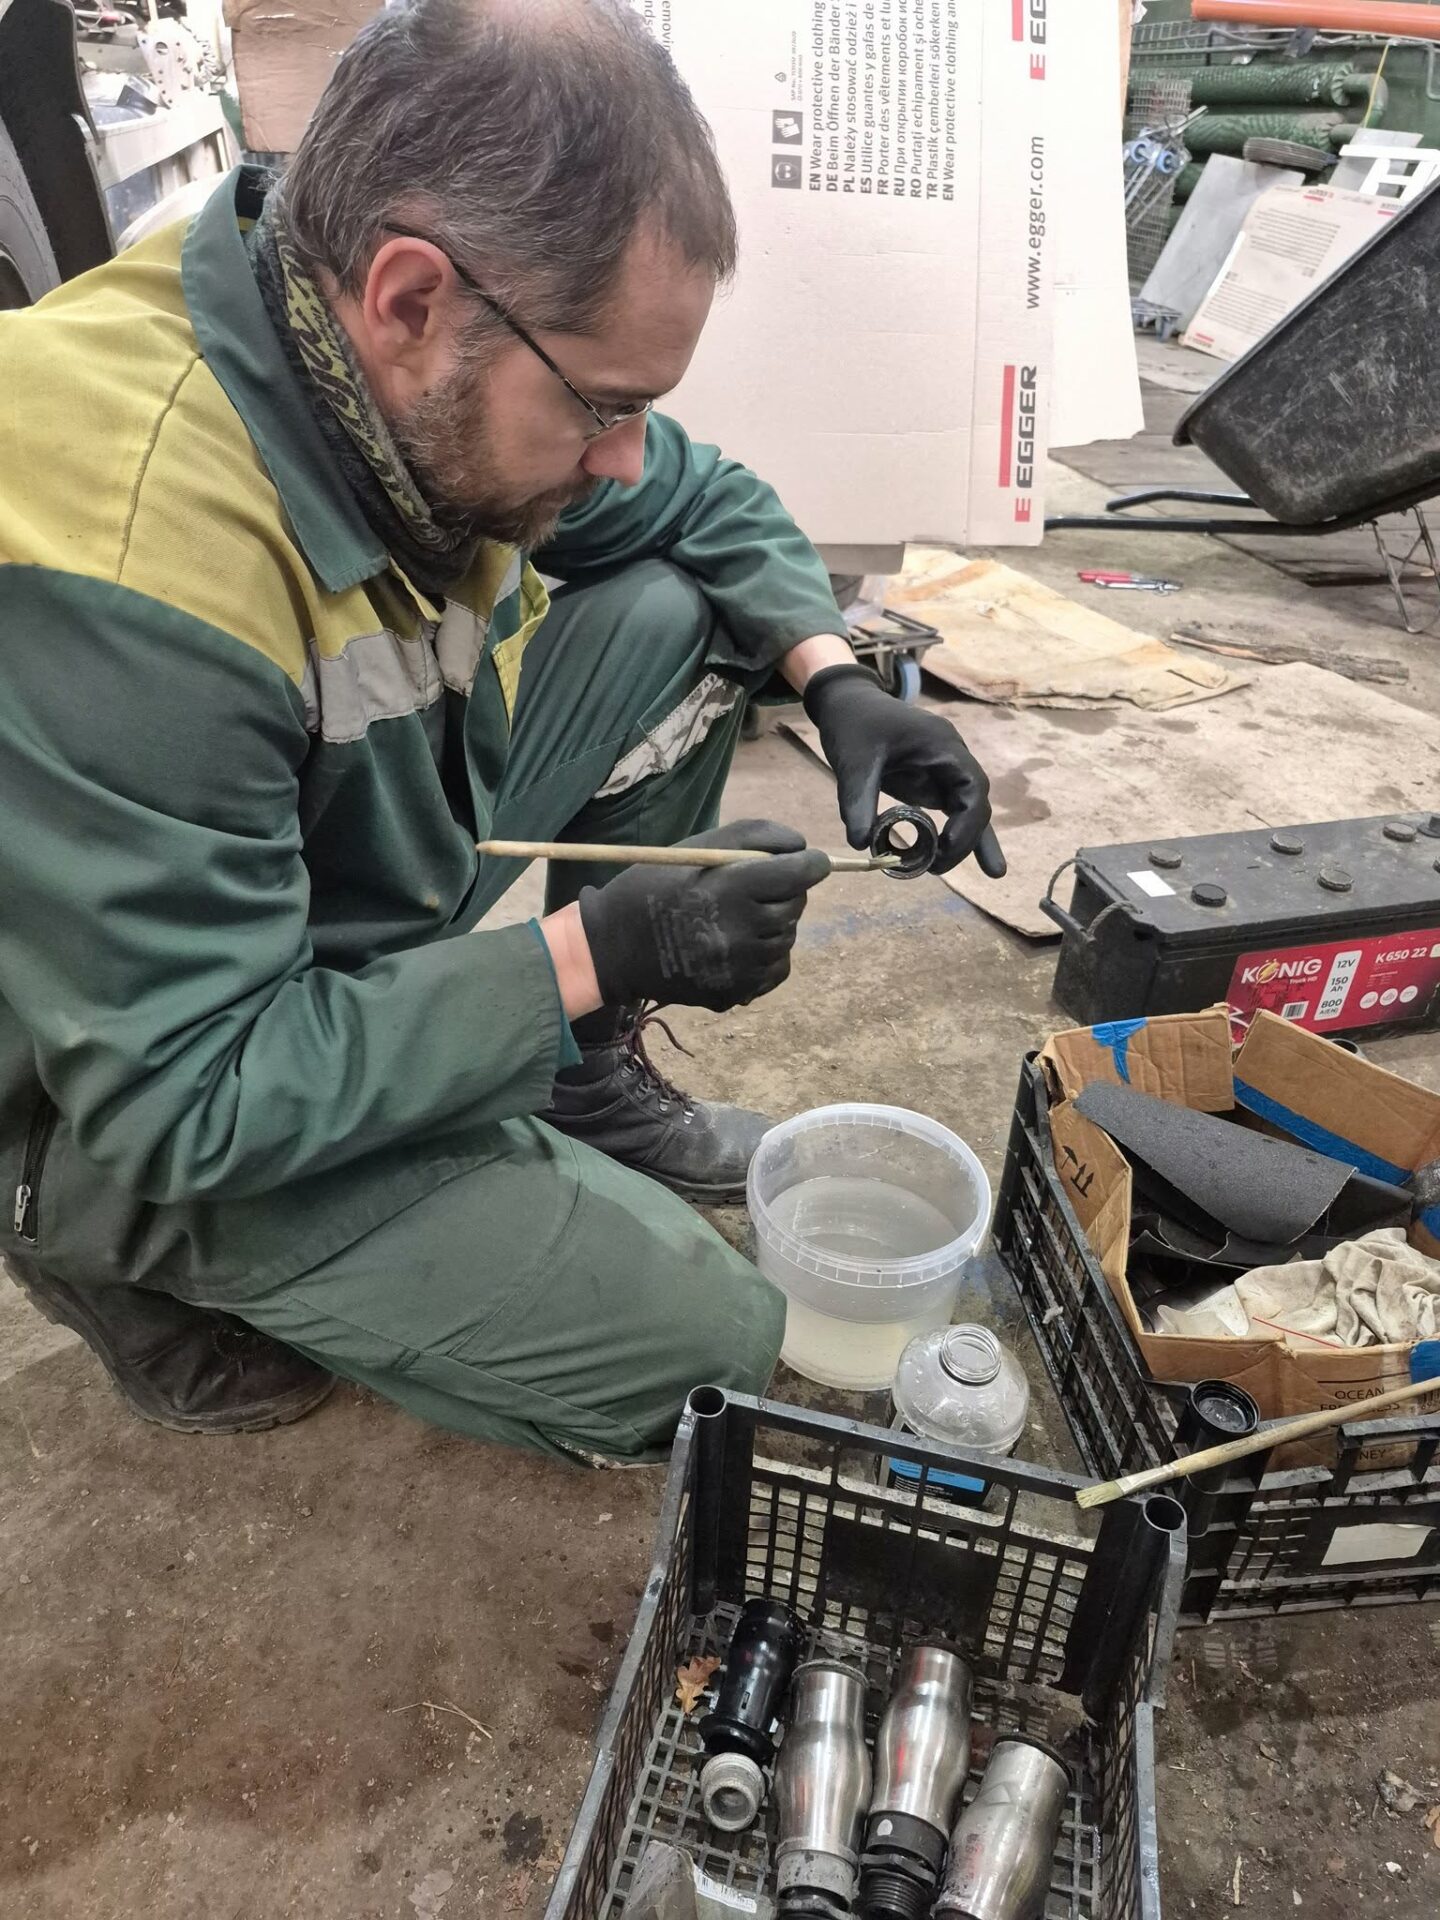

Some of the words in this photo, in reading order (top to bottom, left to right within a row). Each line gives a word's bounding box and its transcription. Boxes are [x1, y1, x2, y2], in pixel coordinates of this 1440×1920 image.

[863, 3, 874, 20] de
[879, 0, 891, 13] lu
[662, 0, 674, 51] emovin
[812, 2, 825, 57] clothing
[828, 7, 841, 54] Bänder
[847, 12, 858, 55] odzież
[880, 18, 891, 30] et
[928, 3, 940, 59] sökerken
[863, 24, 876, 59] gafas
[896, 17, 909, 75] коробок
[945, 22, 958, 74] clothing
[828, 58, 840, 81] der
[879, 35, 891, 104] vêtements
[812, 62, 824, 130] protective
[845, 60, 857, 123] stosować
[863, 74, 875, 127] guantes
[912, 49, 925, 127] echipament
[927, 64, 941, 133] çemberleri
[826, 86, 840, 131] Öffnen
[879, 109, 890, 132] des
[897, 80, 909, 143] открытии
[944, 79, 957, 143] protective
[811, 135, 822, 169] Wear
[828, 136, 839, 169] Beim
[844, 127, 858, 172] Należy
[861, 132, 873, 173] Utilice
[878, 136, 890, 175] Porter
[894, 148, 907, 173] При
[927, 137, 938, 179] Plastik
[943, 148, 954, 180] Wear
[809, 174, 821, 191] EN
[827, 174, 838, 192] DE
[844, 177, 855, 193] PL
[861, 177, 872, 193] ES
[878, 180, 888, 195] FR
[894, 178, 905, 196] RU
[911, 179, 921, 197] RO
[927, 184, 938, 199] TR
[943, 185, 954, 201] EN
[1025, 136, 1046, 310] www.egger.com
[1016, 365, 1037, 488] EGGER
[1337, 958, 1356, 968] 12V
[1411, 947, 1427, 958] 22
[1241, 958, 1322, 985] KÖNIG
[1331, 976, 1349, 985] 150
[1321, 999, 1342, 1008] 800
[1335, 1387, 1384, 1400] OCEAN
[1337, 1449, 1386, 1461] HNEY
